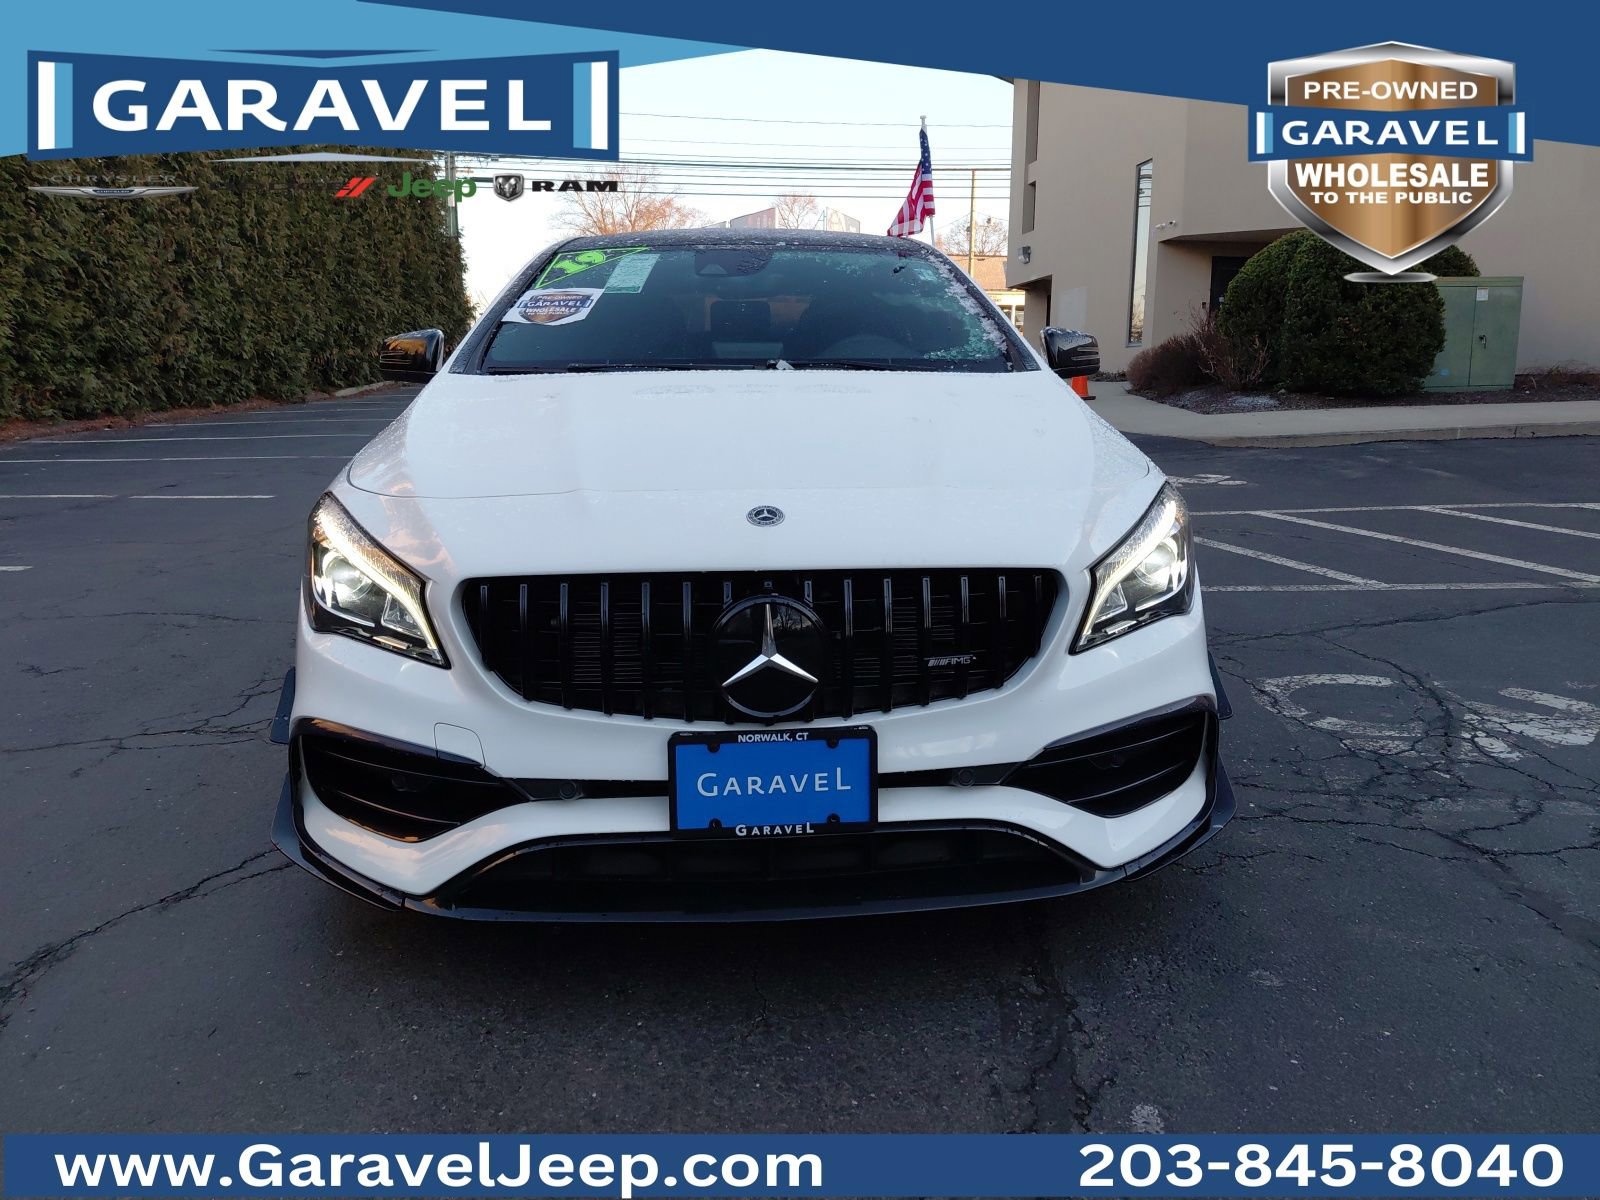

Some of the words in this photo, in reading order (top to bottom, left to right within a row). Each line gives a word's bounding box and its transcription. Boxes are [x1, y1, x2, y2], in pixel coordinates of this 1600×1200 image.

[737, 733, 793, 743] NORWALK,
[795, 732, 809, 741] CT
[697, 767, 851, 797] GARAVEL
[735, 822, 814, 837] GARAVEL
